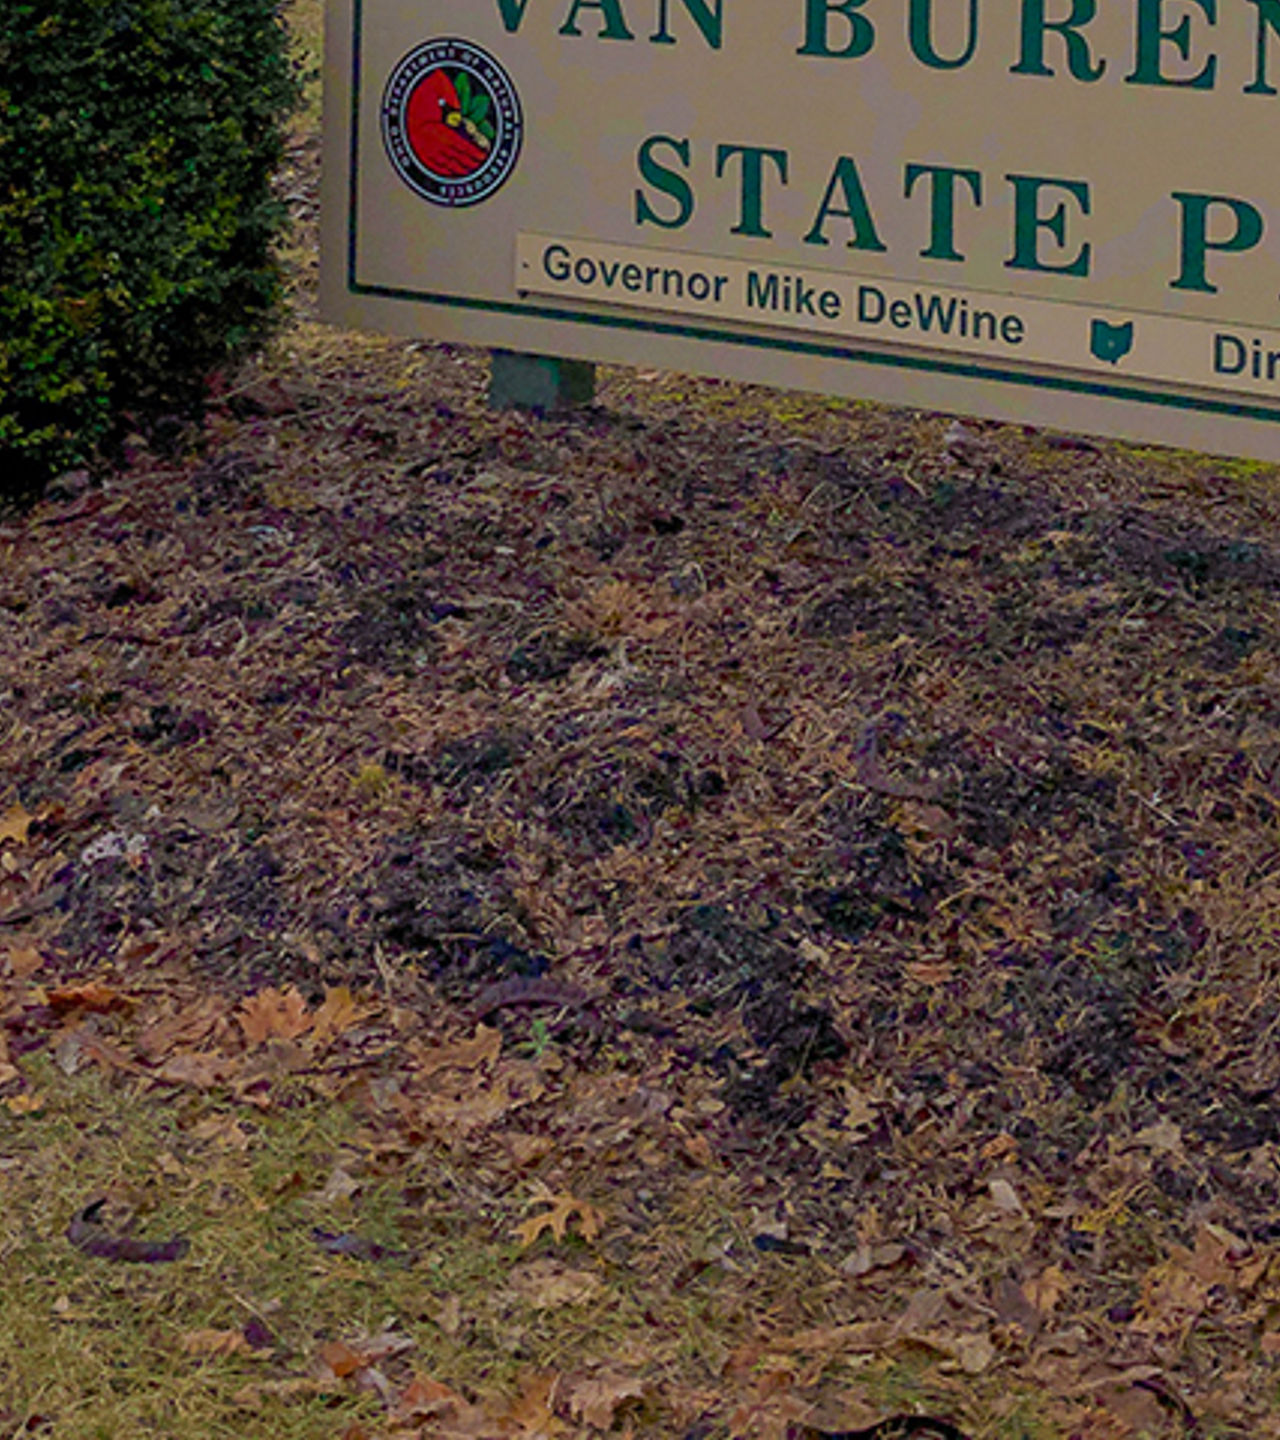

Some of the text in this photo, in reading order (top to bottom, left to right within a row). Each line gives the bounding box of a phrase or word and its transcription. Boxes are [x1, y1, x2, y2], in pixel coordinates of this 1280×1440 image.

[633, 133, 1091, 278] STATE
[542, 244, 1025, 345] Governor Mike DeWine
